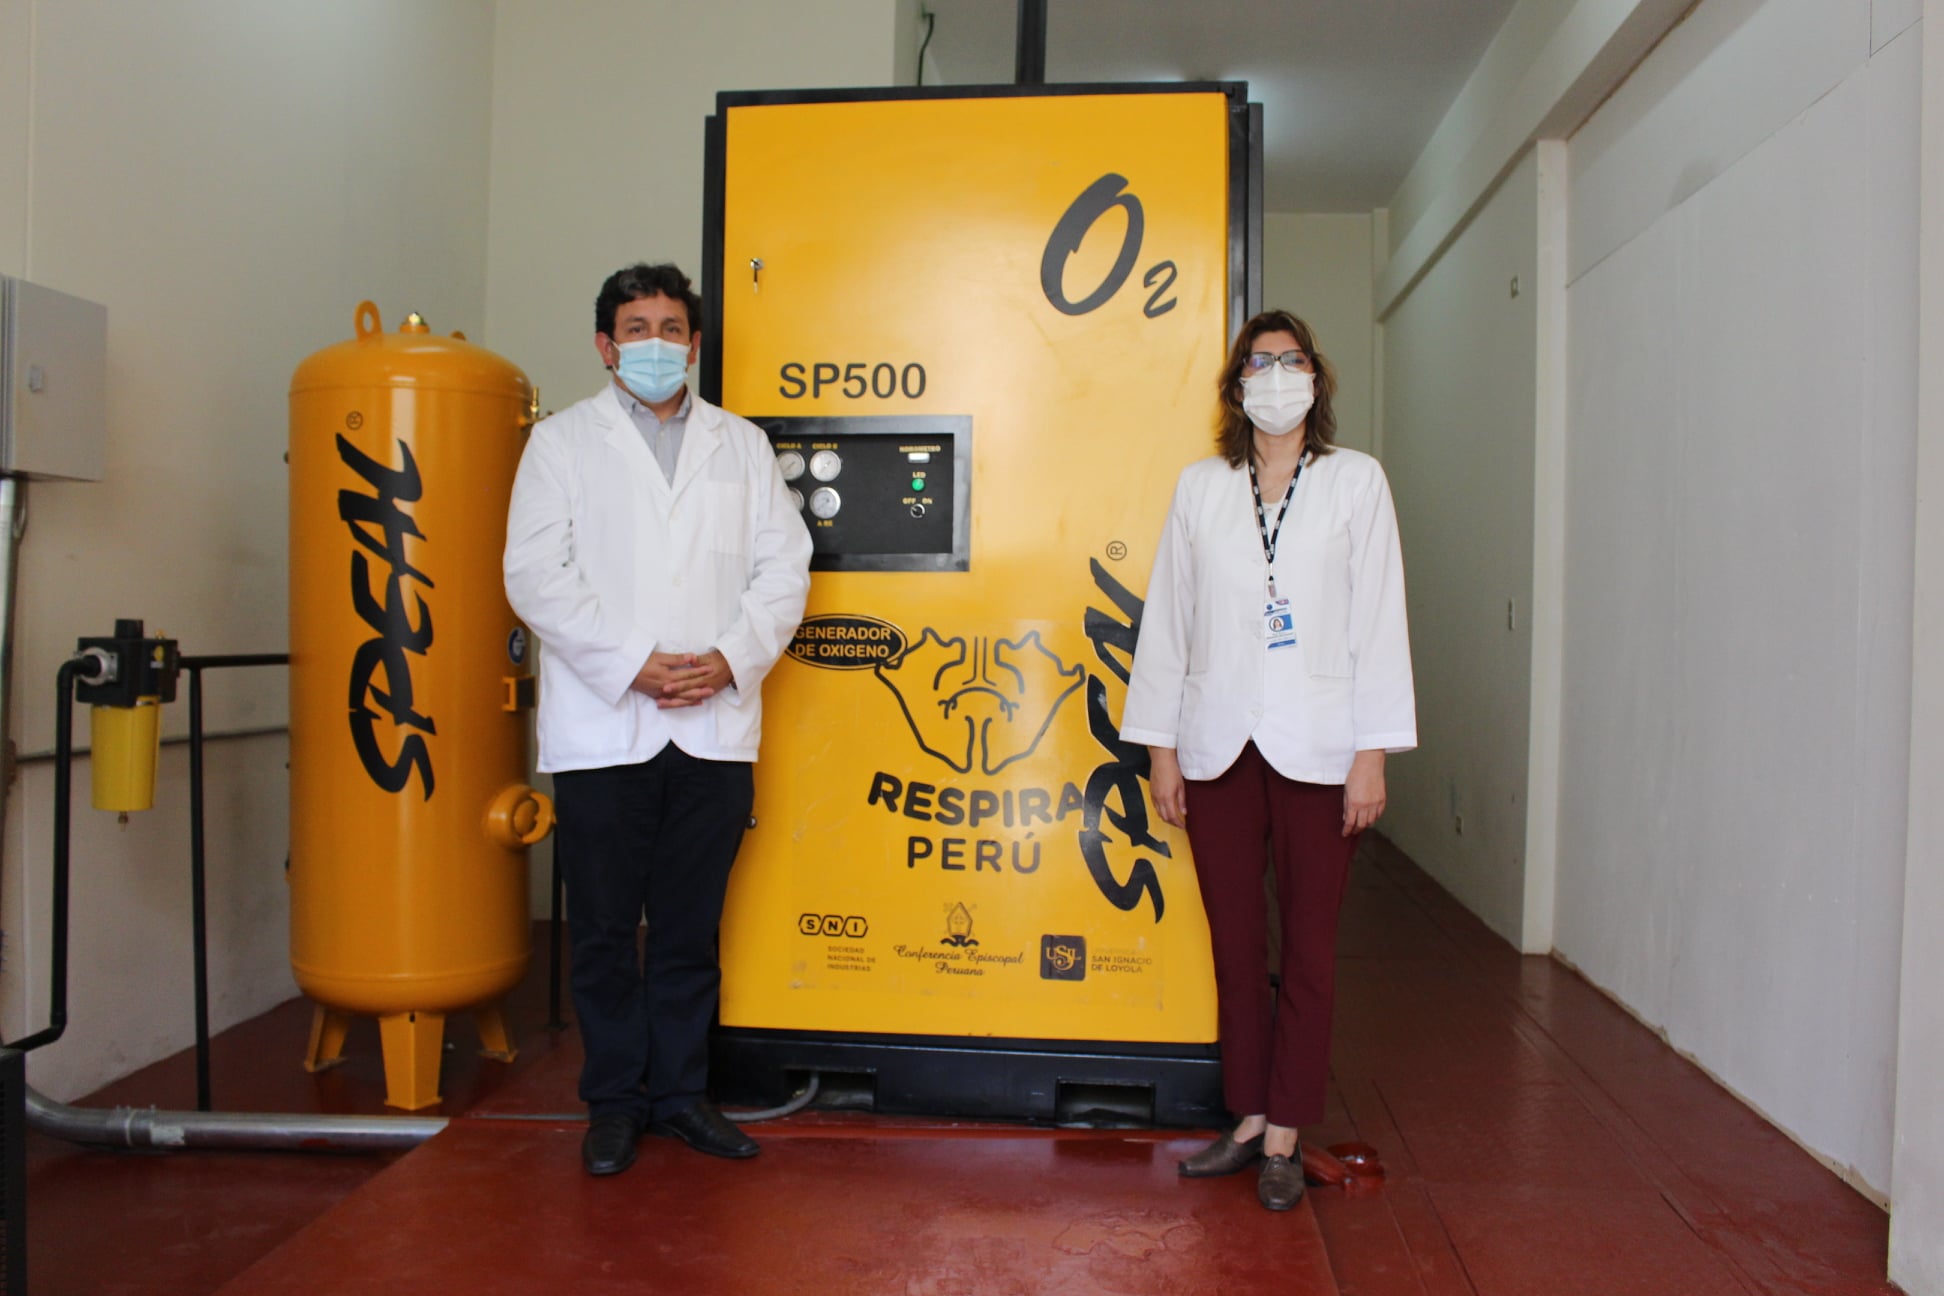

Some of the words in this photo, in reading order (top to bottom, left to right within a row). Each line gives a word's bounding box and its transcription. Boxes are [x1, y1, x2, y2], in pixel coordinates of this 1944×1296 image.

[778, 362, 927, 399] SP500
[912, 471, 926, 479] LED
[335, 432, 437, 803] SPEAL
[795, 626, 892, 640] GENERADOR
[795, 644, 815, 657] DE
[819, 645, 890, 658] OXIGENO
[867, 771, 1086, 829] RESPIRA
[907, 832, 1041, 873] PERÚ
[803, 917, 862, 934] SNI
[893, 944, 961, 962] Conferencia
[964, 948, 1024, 966] Episcopal
[1091, 955, 1111, 963] SAN
[1113, 956, 1152, 965] IGNACIO
[934, 961, 984, 976] Peruana
[1091, 964, 1103, 972] DE
[1106, 965, 1143, 973] LOYOLA
